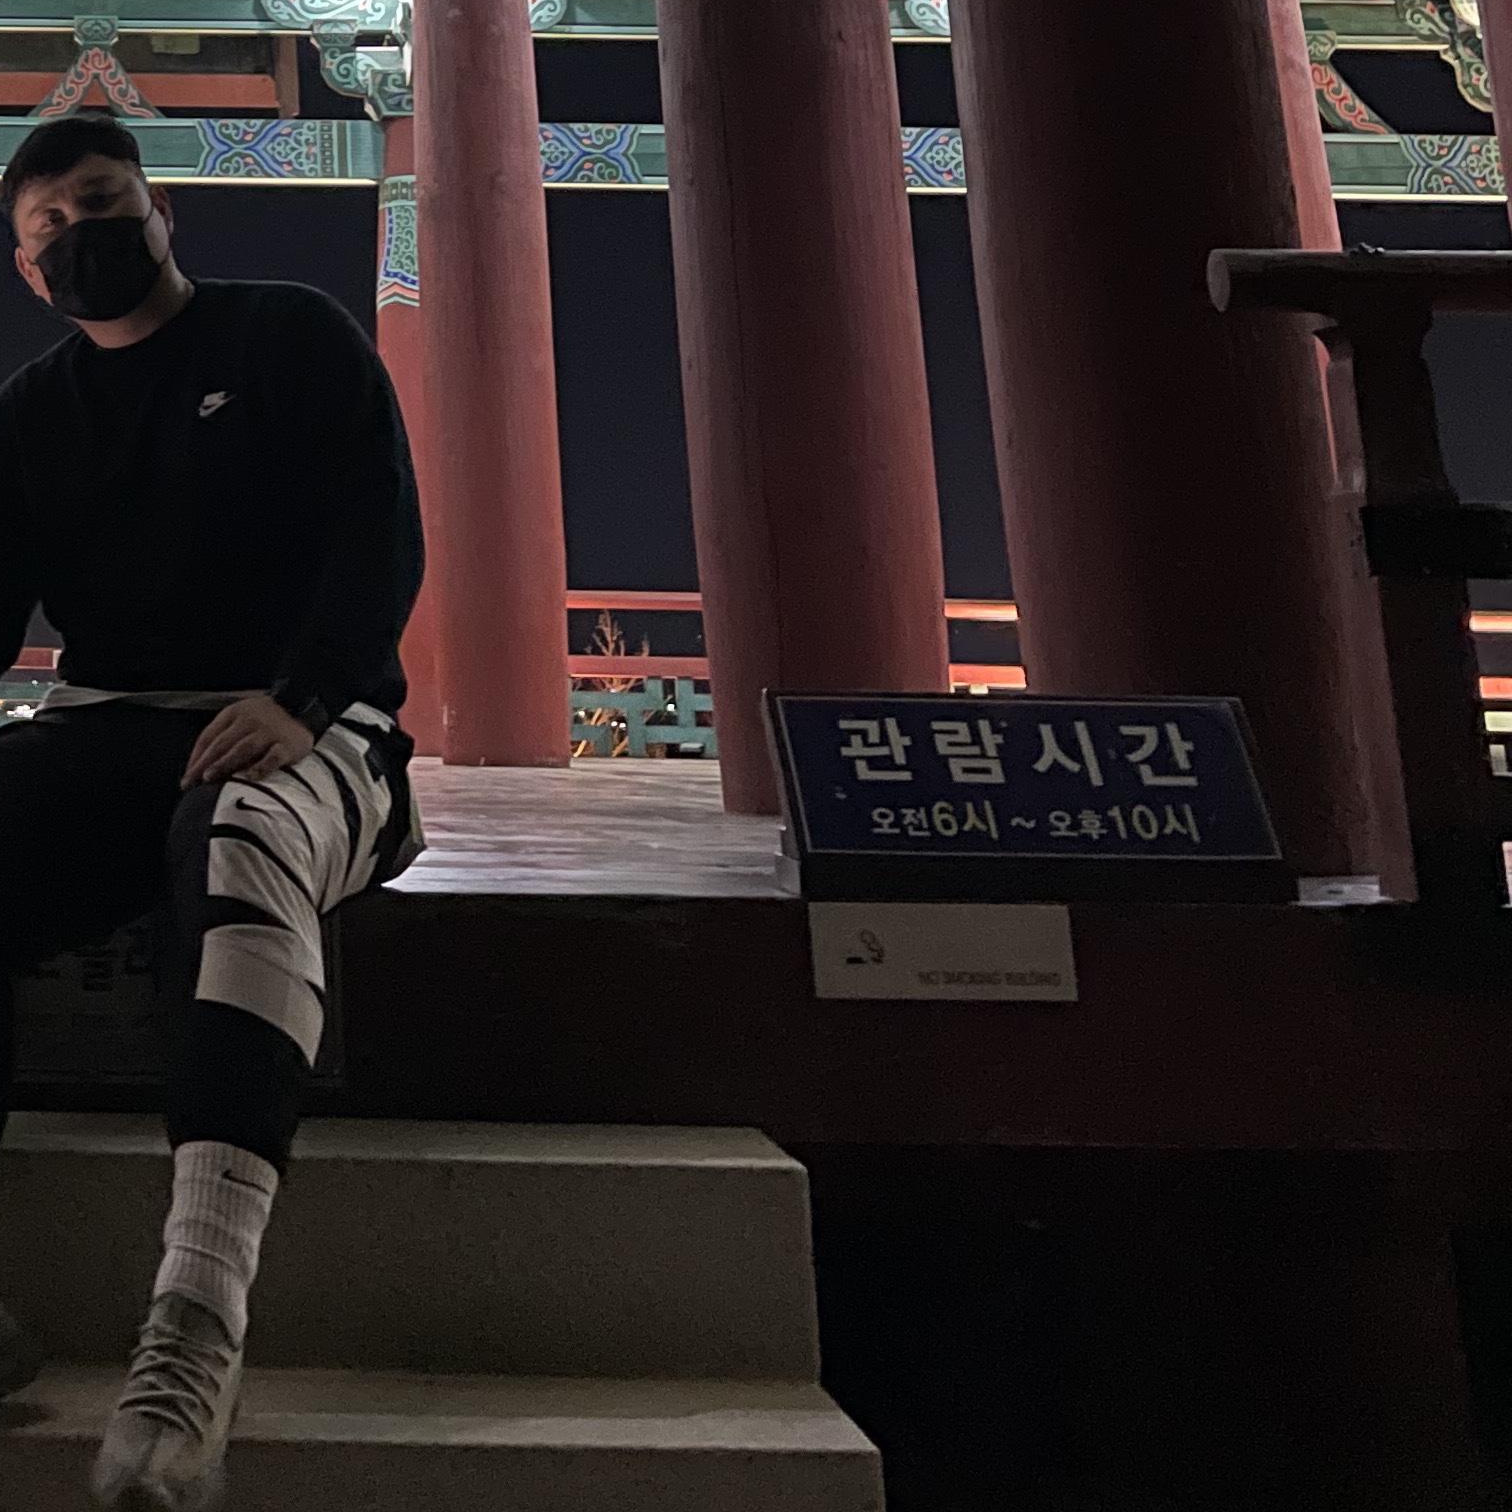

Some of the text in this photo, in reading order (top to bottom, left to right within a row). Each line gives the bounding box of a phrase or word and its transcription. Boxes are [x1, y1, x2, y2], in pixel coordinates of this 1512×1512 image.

[838, 717, 1199, 787] 관람시간
[871, 800, 999, 840] 오전6시
[1048, 803, 1201, 844] 오후10시
